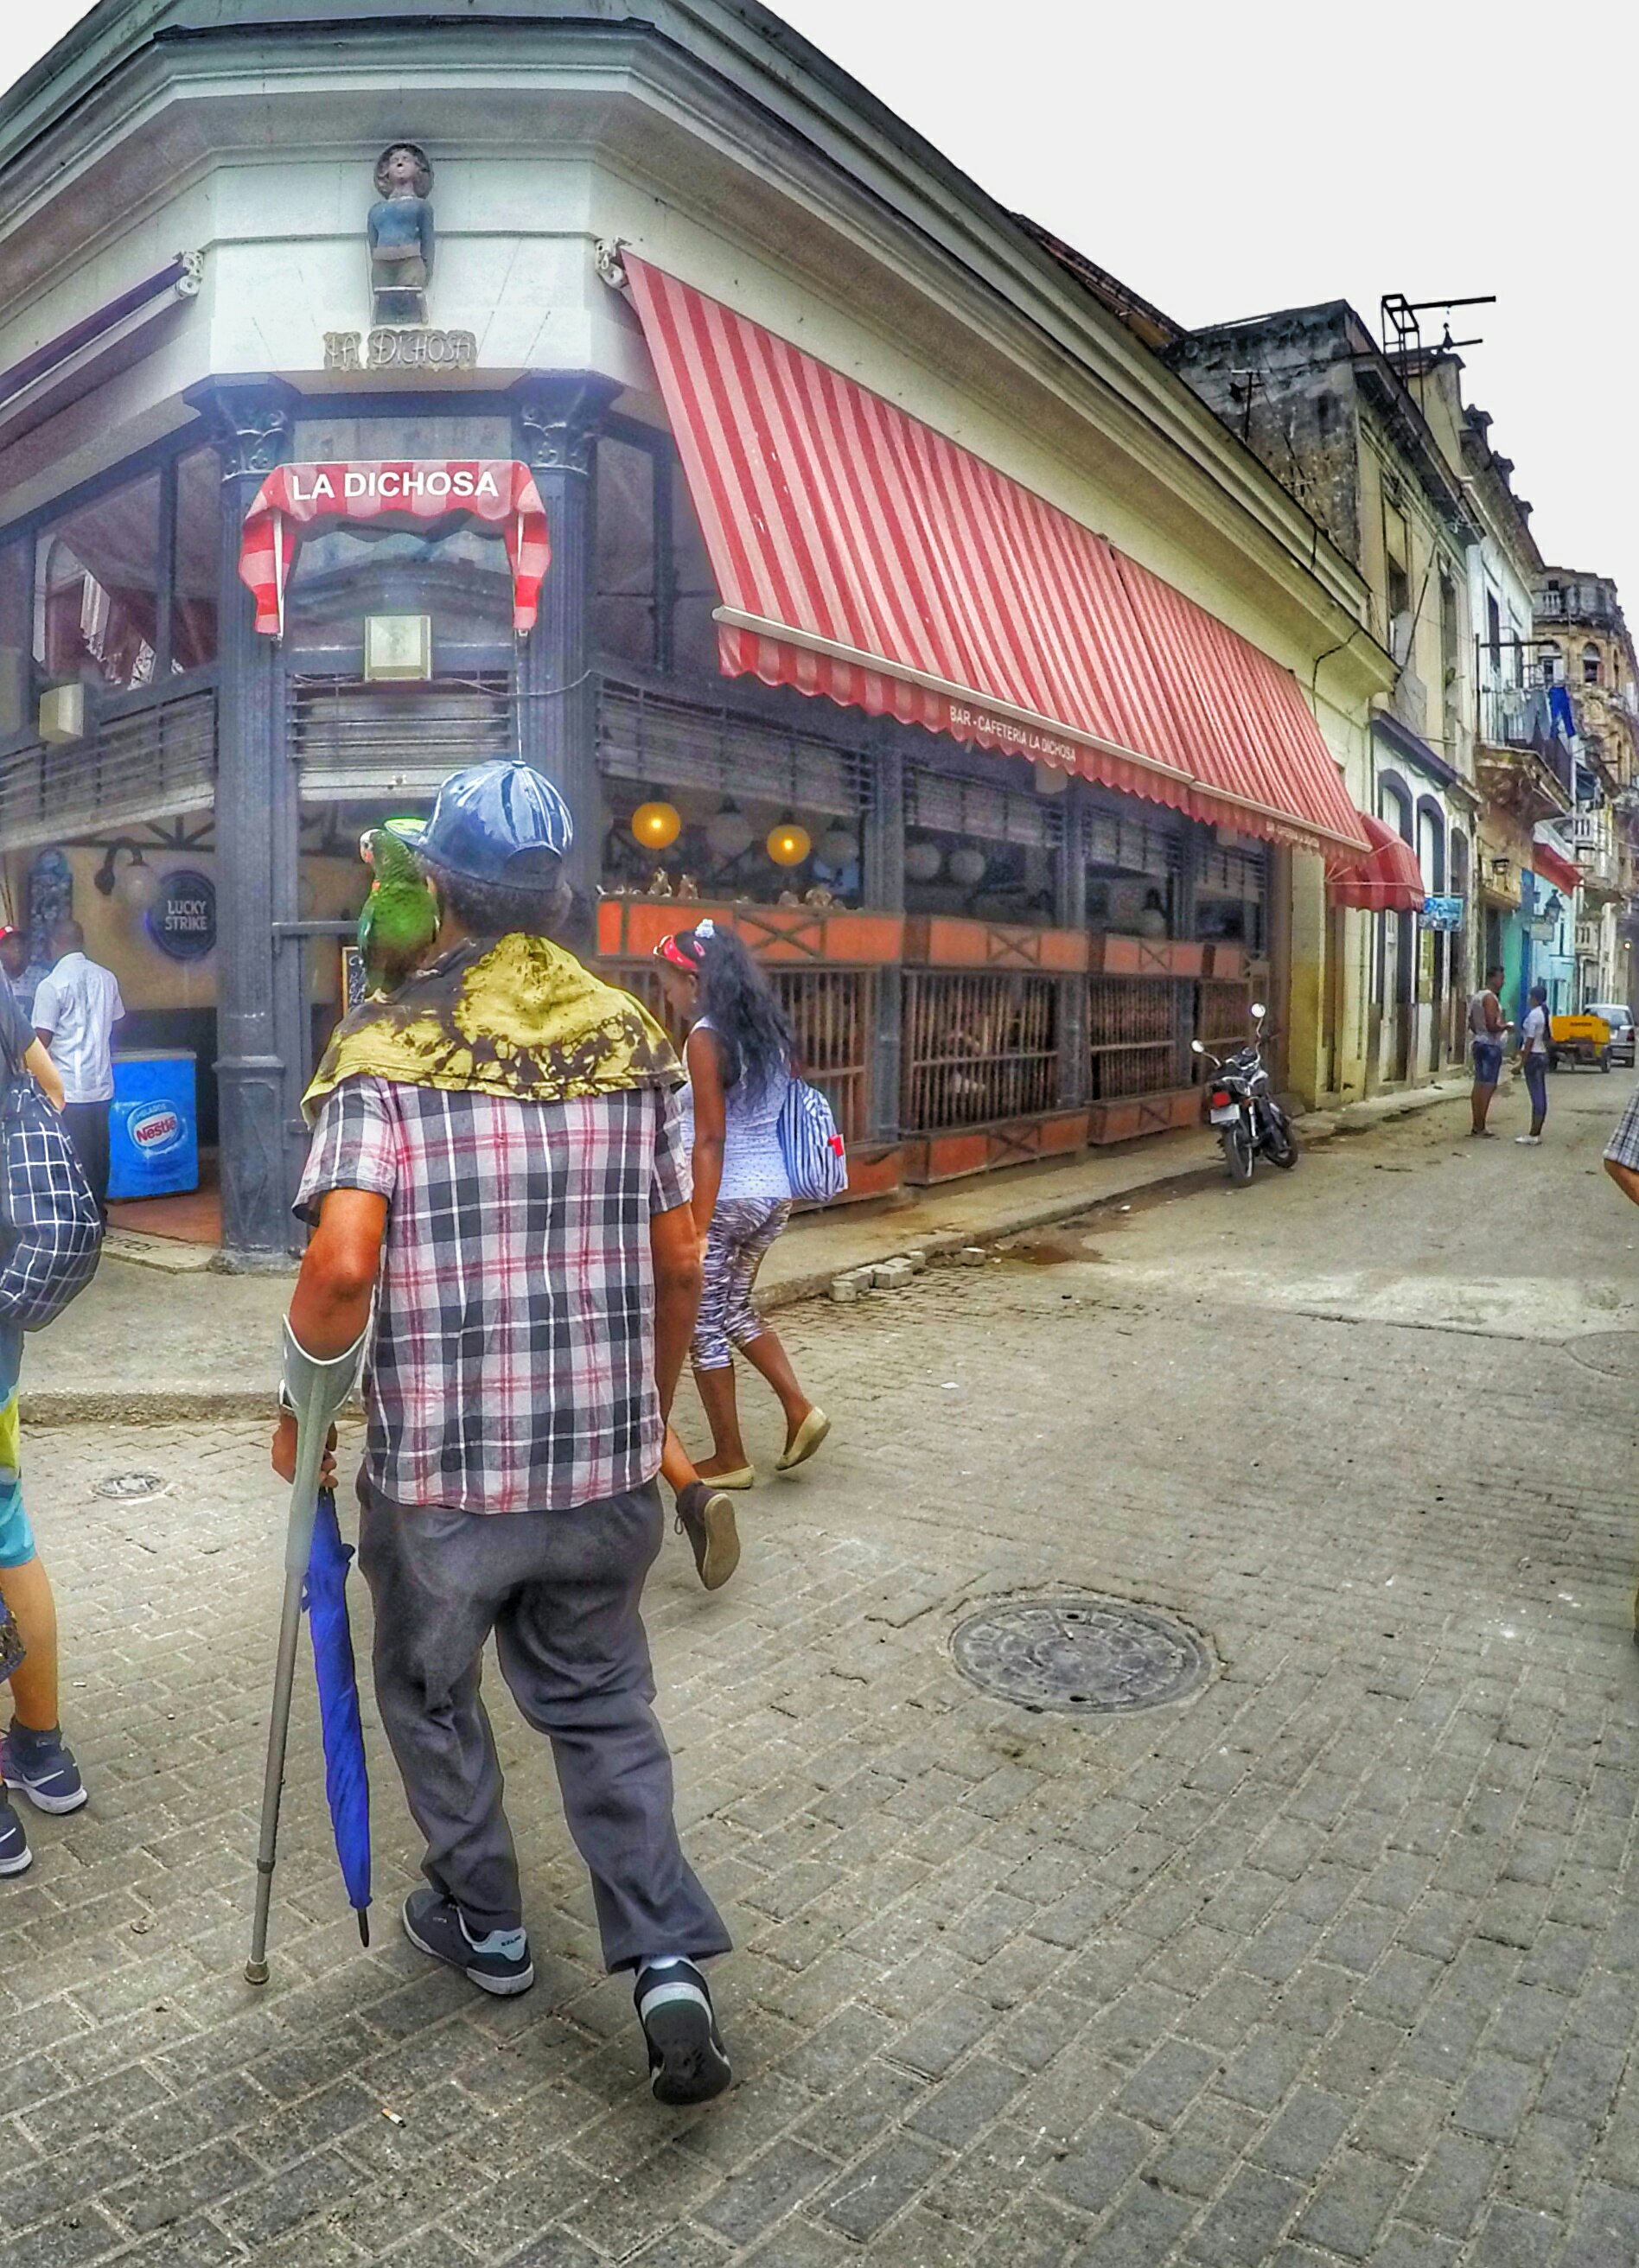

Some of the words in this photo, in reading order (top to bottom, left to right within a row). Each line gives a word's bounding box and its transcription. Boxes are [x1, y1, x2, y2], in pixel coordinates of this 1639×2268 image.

[327, 335, 359, 368] LA
[372, 331, 471, 365] DICHOSA
[292, 474, 335, 501] LA
[344, 471, 499, 498] DICHOSA
[949, 704, 971, 726] BAR
[1029, 733, 1041, 750] LA
[1041, 737, 1076, 762] DICHOSA
[167, 900, 207, 915] LUCKY
[165, 915, 207, 931] STRIKE
